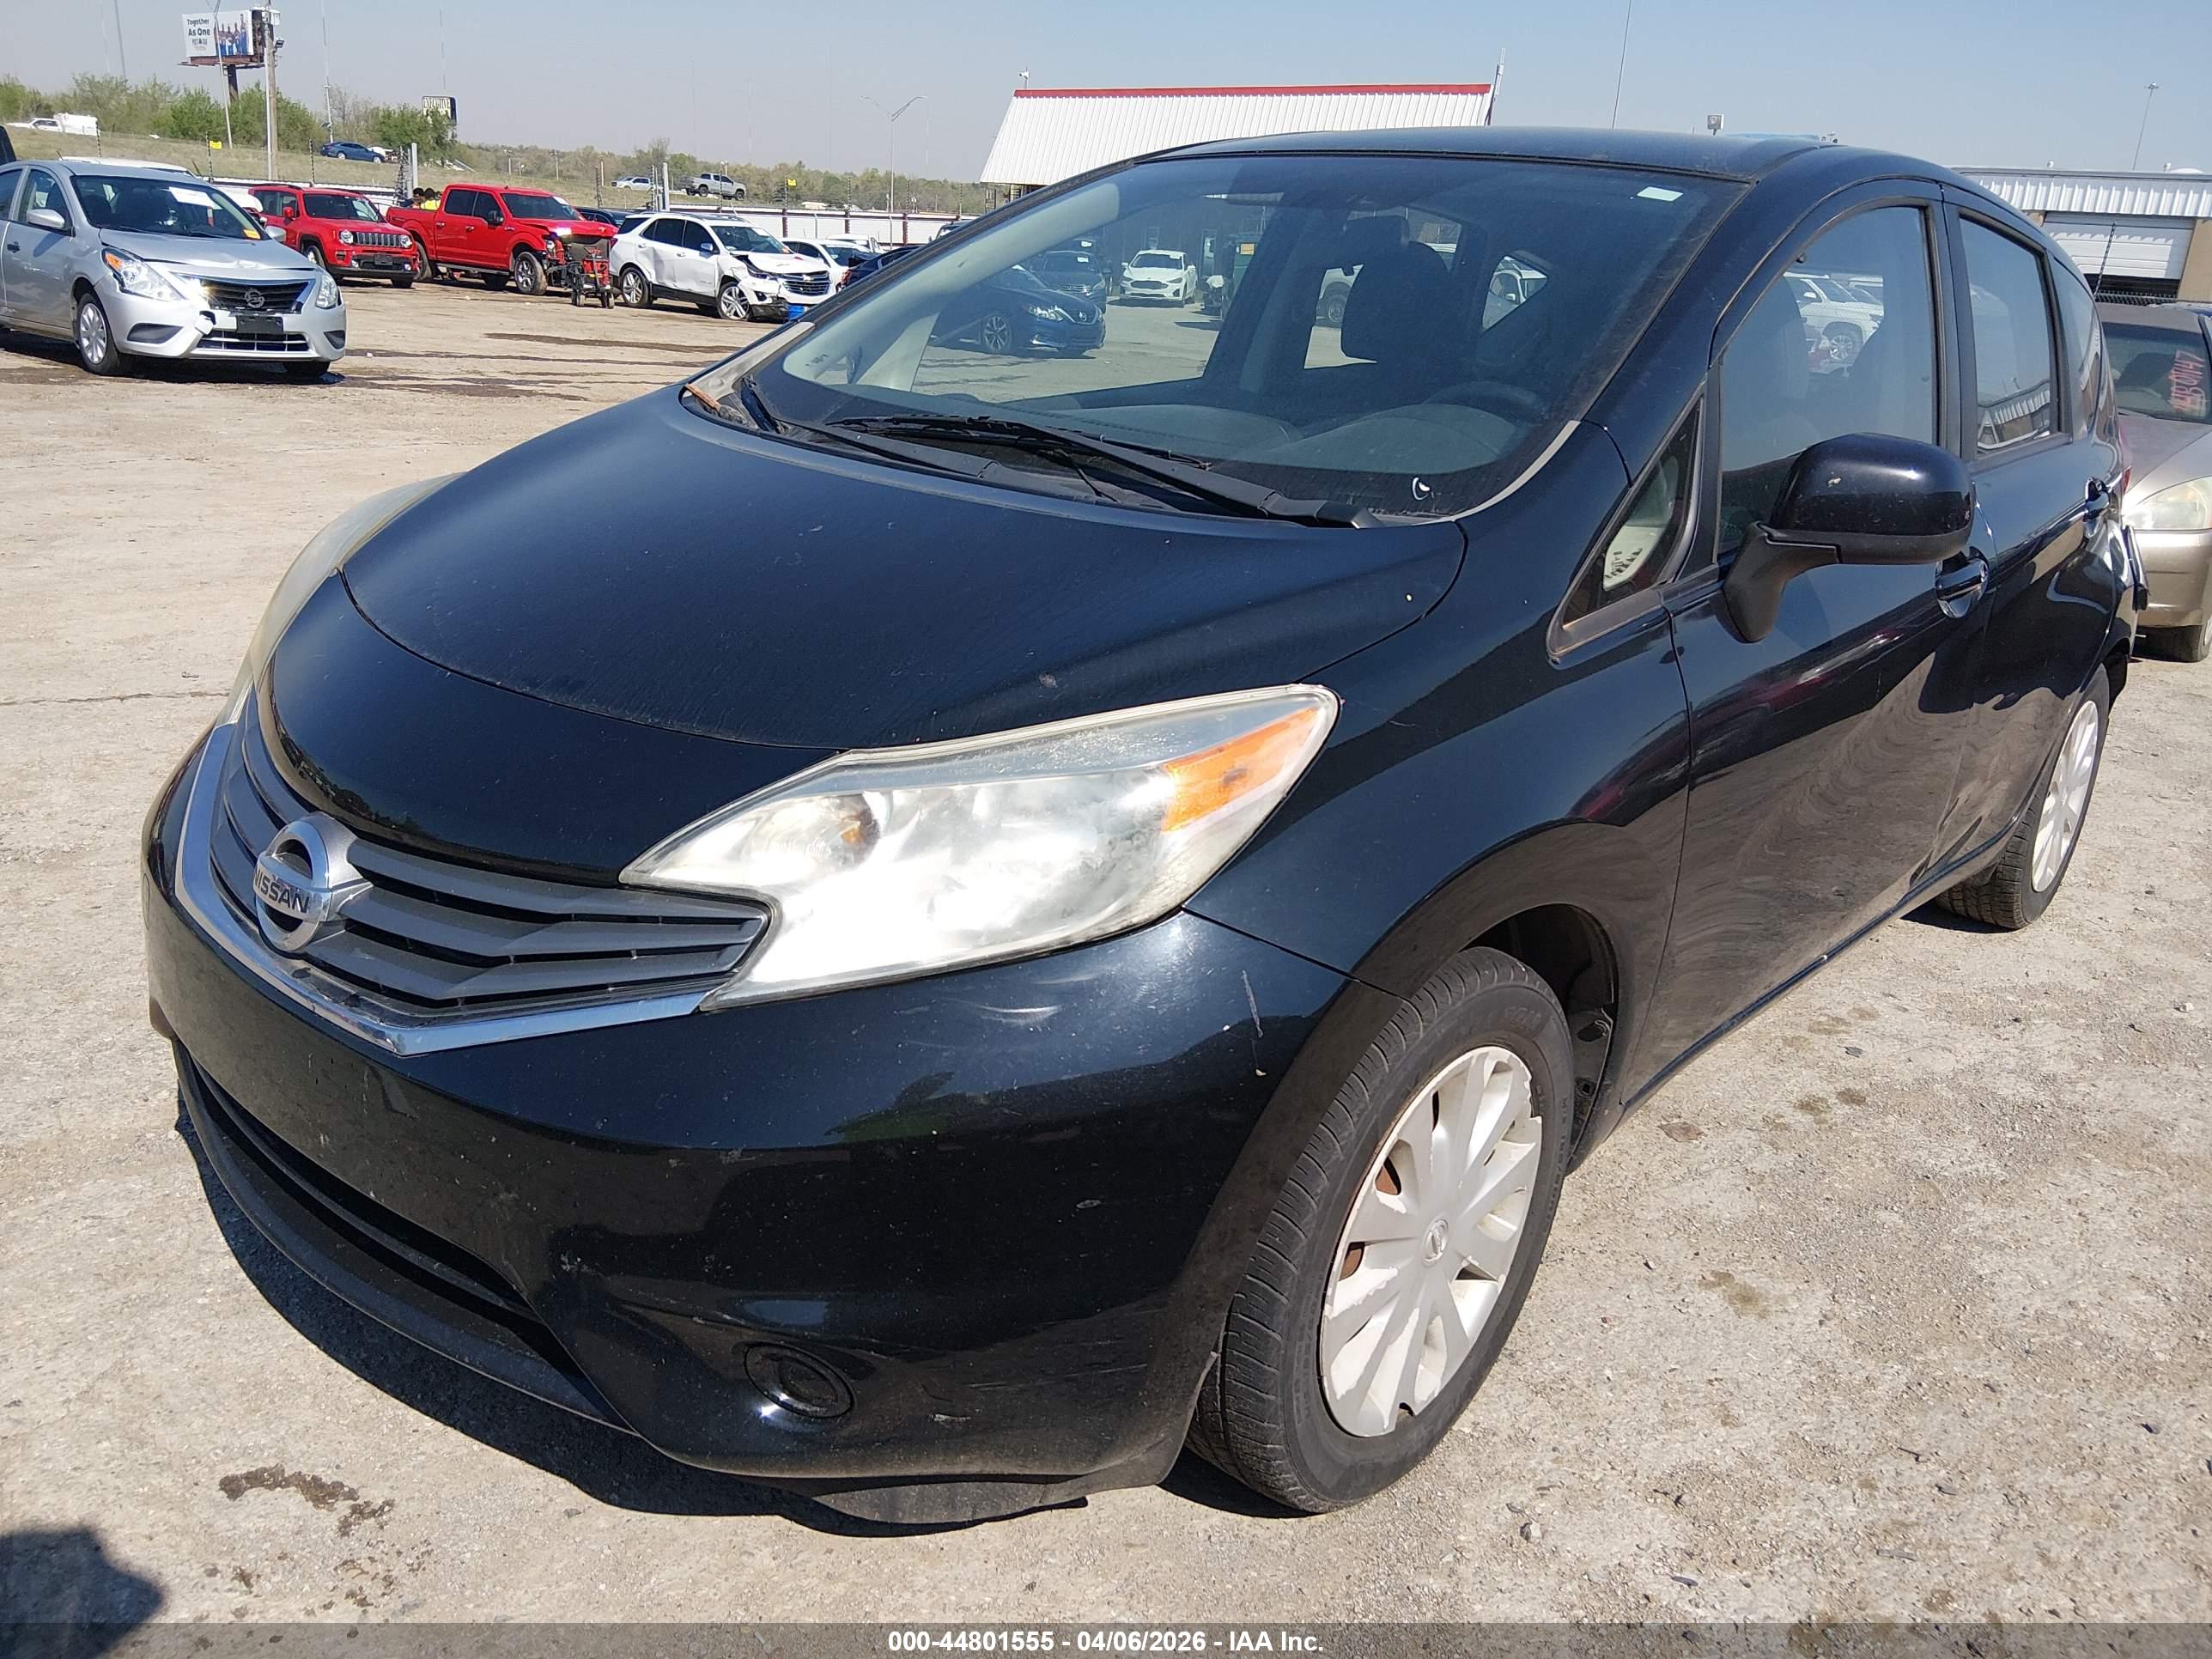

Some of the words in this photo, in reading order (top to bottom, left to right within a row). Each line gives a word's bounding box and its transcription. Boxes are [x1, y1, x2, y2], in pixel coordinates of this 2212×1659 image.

[186, 18, 210, 27] Together
[197, 27, 210, 36] One
[254, 868, 310, 914] NISSAN
